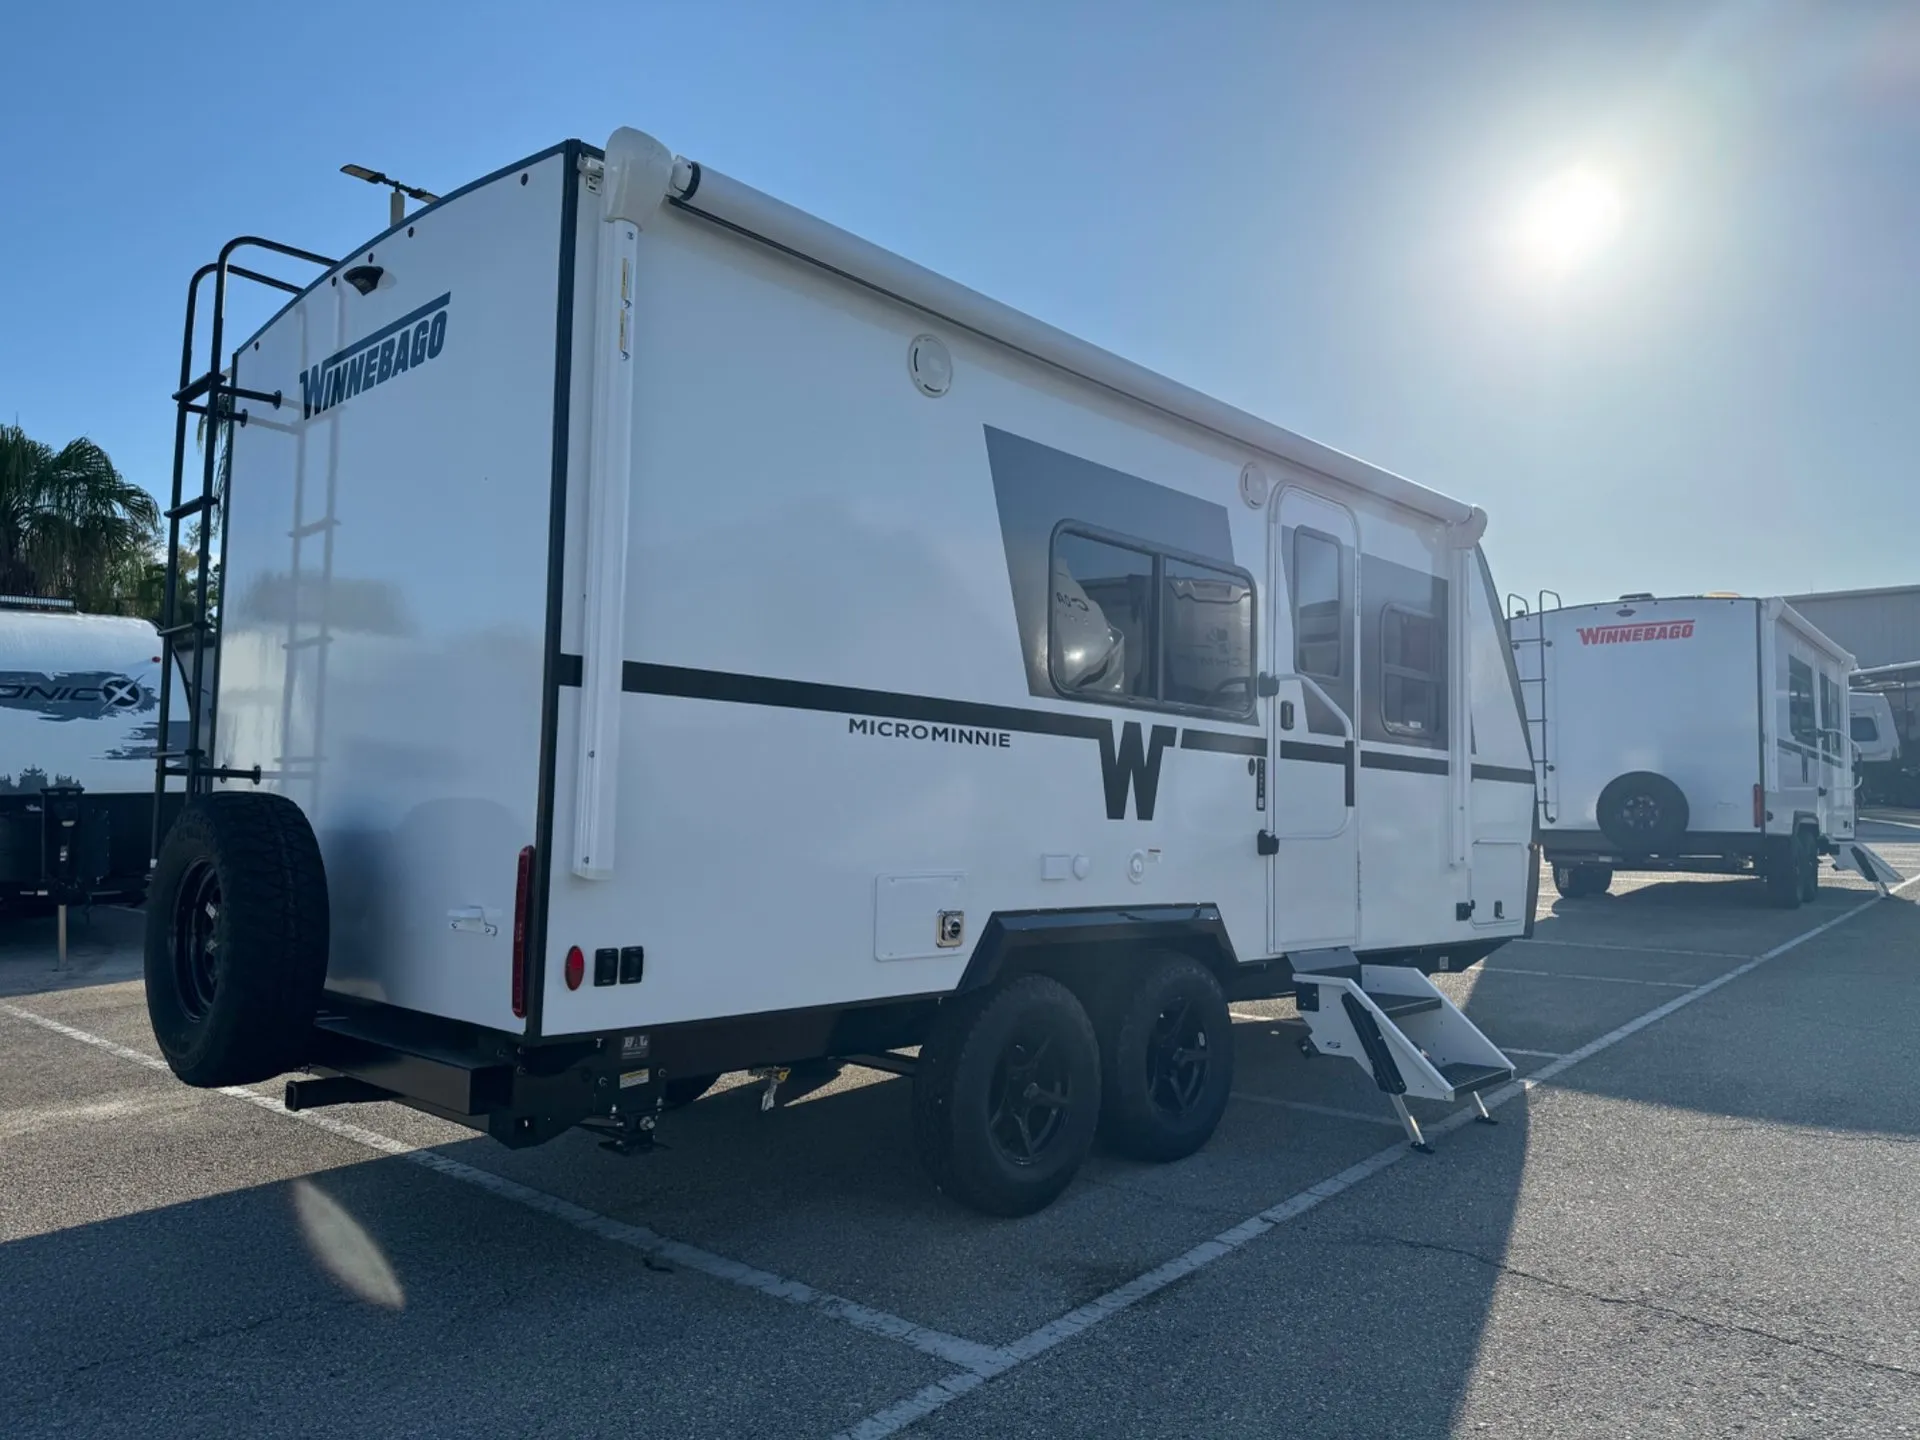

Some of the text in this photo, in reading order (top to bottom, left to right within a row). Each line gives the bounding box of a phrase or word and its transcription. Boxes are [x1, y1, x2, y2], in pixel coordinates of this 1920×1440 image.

[300, 291, 451, 420] WINNEBAGO
[1576, 619, 1695, 645] WINNEBAGO
[848, 718, 1011, 748] MICROMINNIE
[1098, 719, 1177, 821] W
